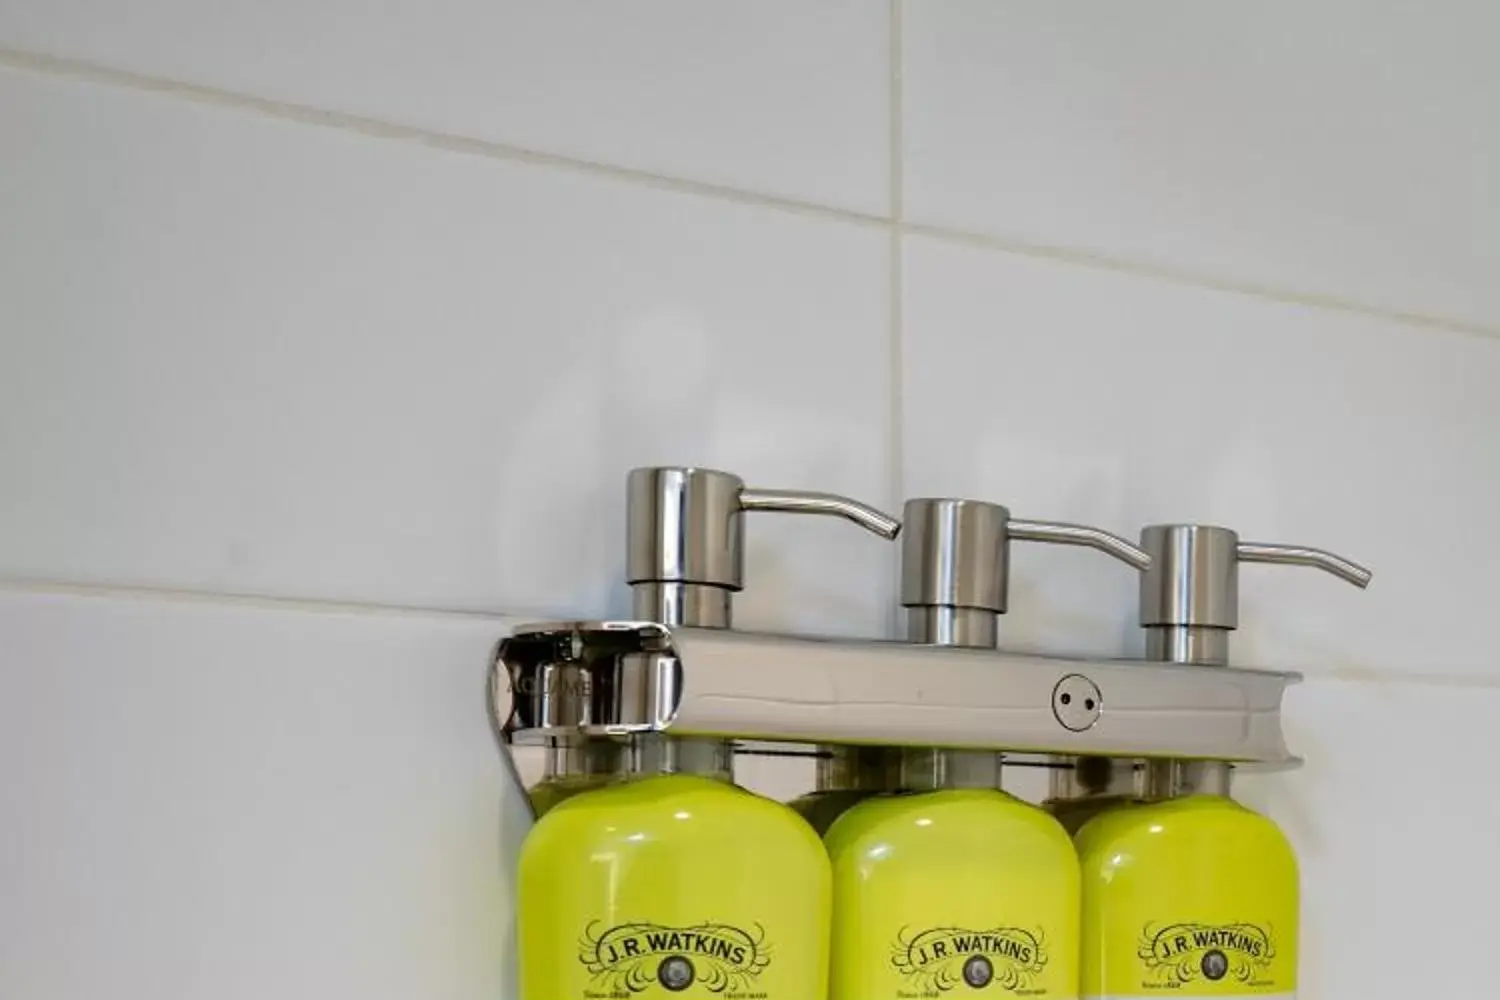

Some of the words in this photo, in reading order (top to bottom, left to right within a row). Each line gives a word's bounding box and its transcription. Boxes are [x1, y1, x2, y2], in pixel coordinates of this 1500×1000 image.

[647, 932, 746, 965] WATKINS
[953, 935, 1032, 964] WATKINS
[1193, 931, 1262, 957] WATKINS
